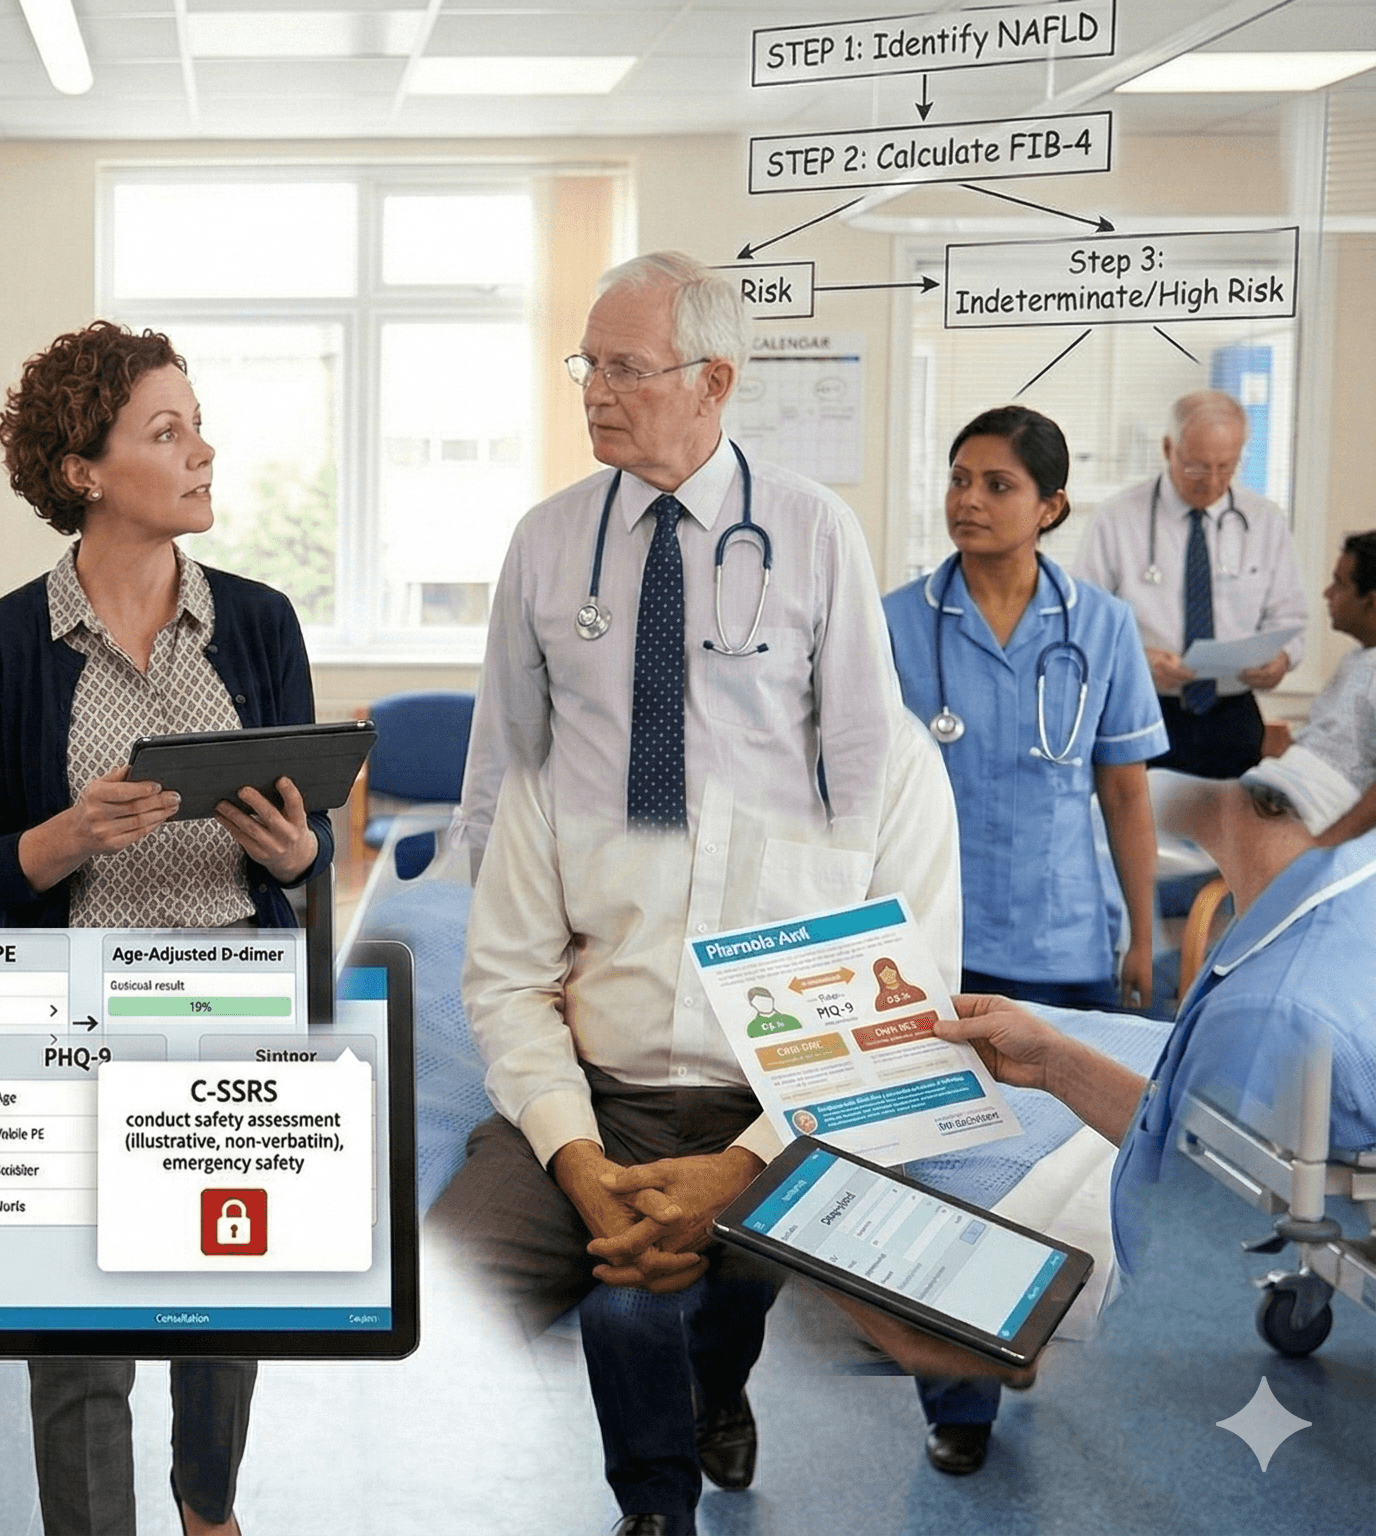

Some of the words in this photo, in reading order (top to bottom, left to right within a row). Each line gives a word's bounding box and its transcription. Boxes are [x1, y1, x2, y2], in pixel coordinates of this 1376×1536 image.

[112, 947, 217, 965] Age-Adjusted
[222, 947, 284, 962] D-dimer
[155, 980, 185, 991] result
[189, 1001, 212, 1012] 19%
[44, 1047, 112, 1072] PHQ-9
[191, 1079, 278, 1103] C-SSRS
[126, 1111, 191, 1127] conduct
[195, 1111, 244, 1131] safety
[248, 1113, 341, 1127] assessment
[31, 1128, 44, 1140] PE
[125, 1132, 221, 1152] (illustrative,
[163, 1155, 251, 1174] emergency
[255, 1154, 305, 1174] safety
